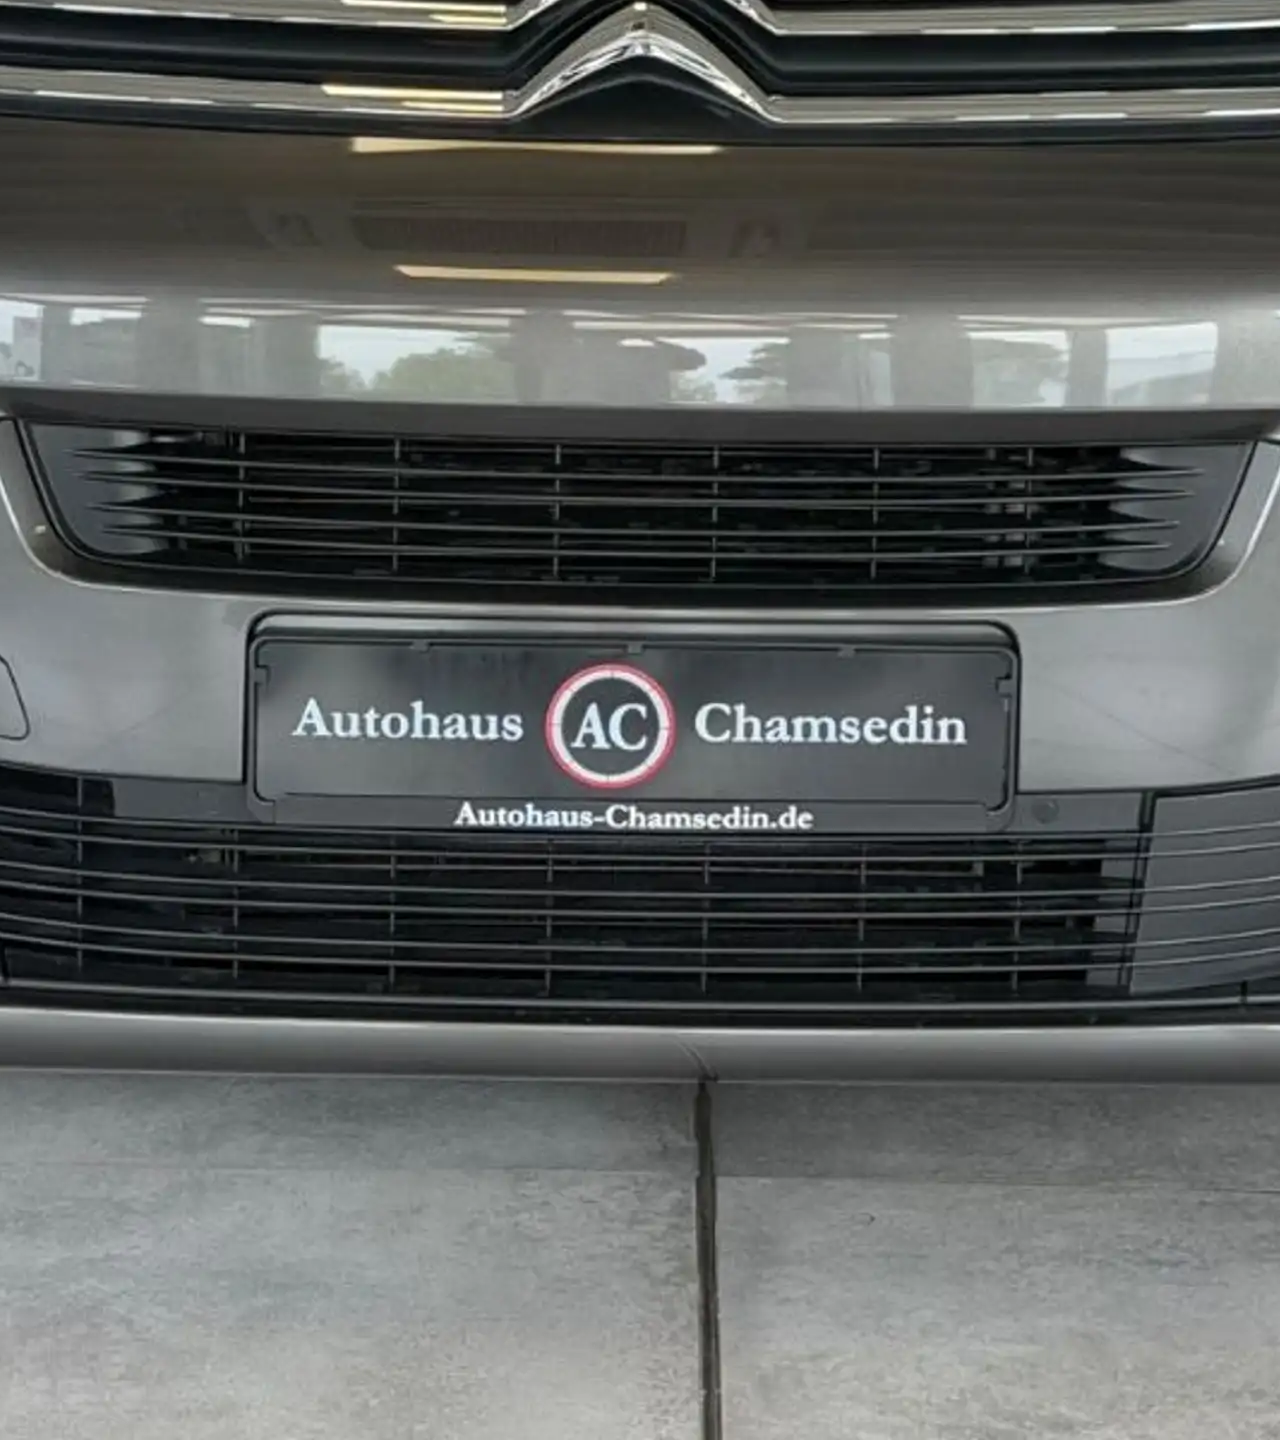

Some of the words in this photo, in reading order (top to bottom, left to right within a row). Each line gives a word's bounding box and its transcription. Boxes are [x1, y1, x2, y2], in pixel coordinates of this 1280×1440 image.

[290, 696, 524, 742] Autohaus
[570, 701, 651, 752] AC
[694, 702, 968, 746] Chamsedin
[453, 800, 814, 831] Autohaus-Chamsedin.de
